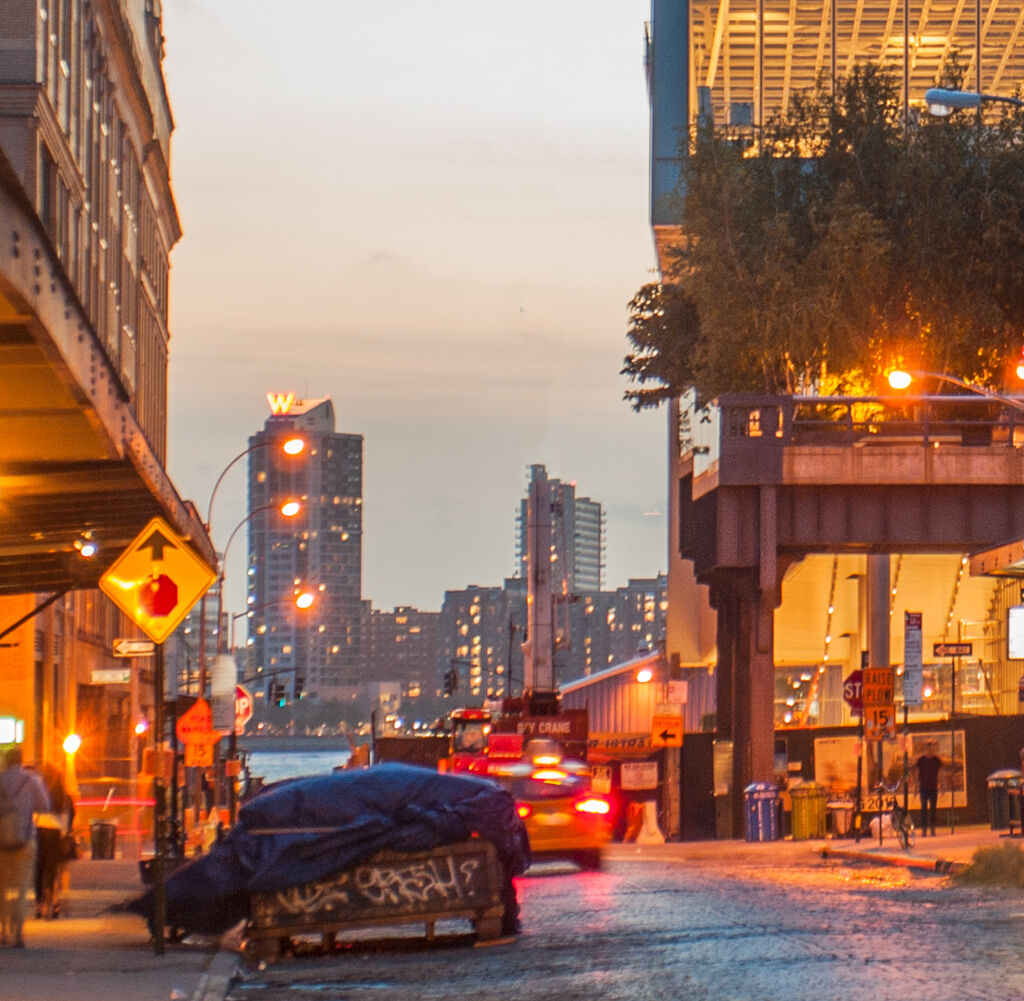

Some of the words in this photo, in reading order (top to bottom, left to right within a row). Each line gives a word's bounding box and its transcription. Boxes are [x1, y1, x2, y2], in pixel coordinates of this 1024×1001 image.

[266, 392, 294, 416] W
[845, 683, 862, 700] ST
[873, 710, 889, 727] 15
[538, 721, 571, 734] CRANE
